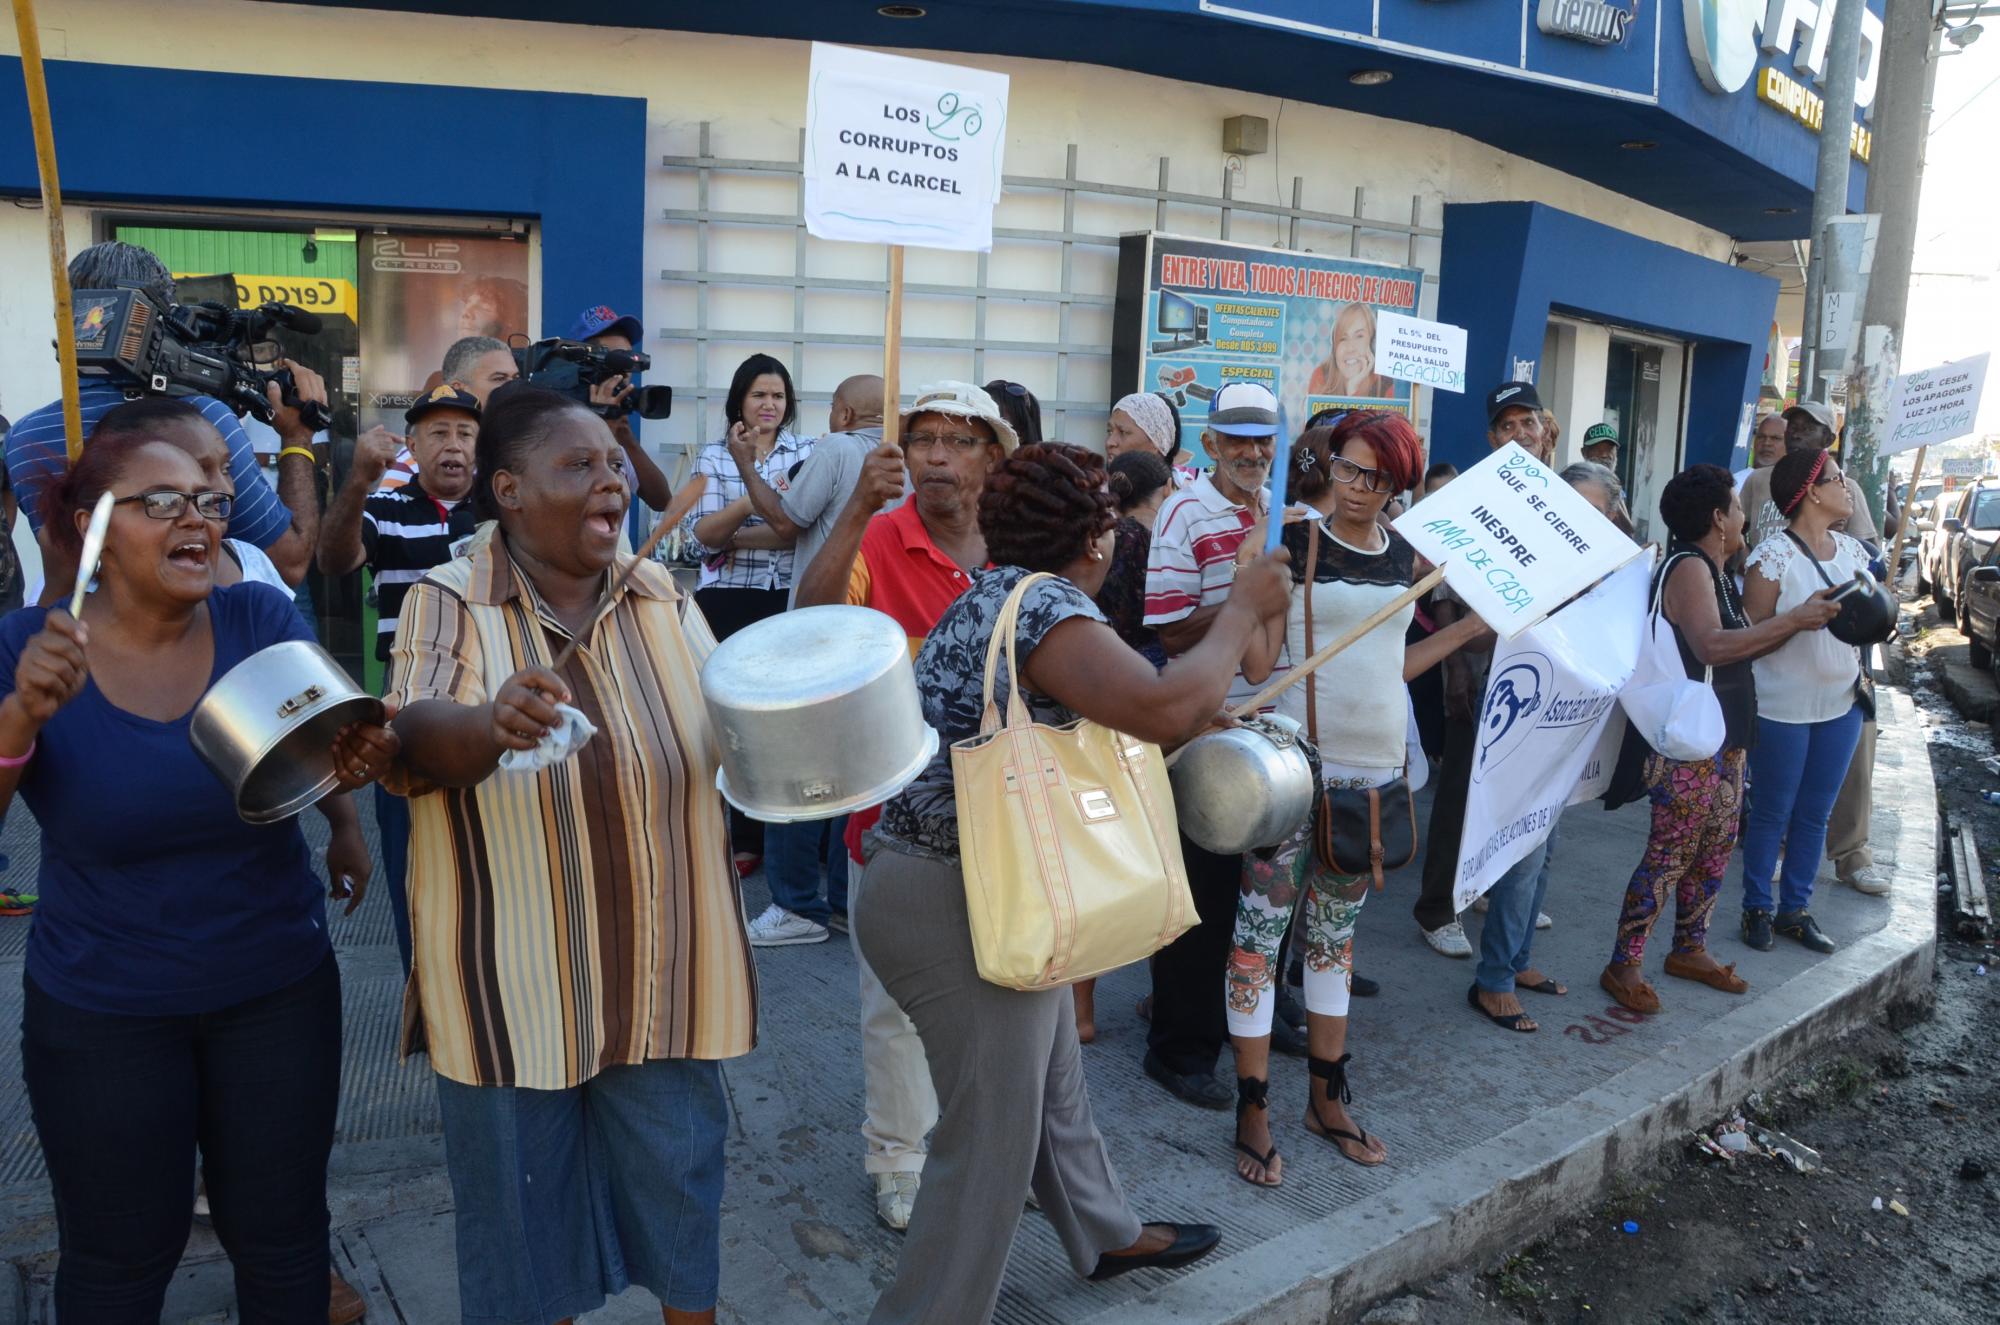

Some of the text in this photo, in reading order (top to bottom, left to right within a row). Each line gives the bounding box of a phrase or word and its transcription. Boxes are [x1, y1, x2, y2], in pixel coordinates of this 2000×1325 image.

[1552, 0, 1627, 44] Genius
[884, 104, 921, 123] LOS
[839, 130, 958, 162] CORRUPTOS
[836, 162, 961, 195] A LA CARCEL
[1162, 255, 1415, 307] ENTRE Y VEA, TODOS A PRECIOS DE LOCURA
[1215, 304, 1280, 317] OFERTAS CALIENTES
[1229, 327, 1264, 338] Completa
[1398, 327, 1441, 341] EL 5% DEL
[1216, 339, 1239, 350] Desde
[1391, 338, 1448, 355] PRESUPUESTO
[1388, 351, 1450, 368] PARA LA SALUD
[1221, 367, 1275, 379] ESPECIAL
[1914, 373, 1969, 392] QUE CESEN
[1902, 384, 1973, 407] LOS APAGONES
[1905, 399, 1965, 418] LUZ 24 HORA
[1500, 470, 1591, 554] QUE SE CIERRE
[1470, 505, 1537, 567] INESPRE
[1422, 519, 1534, 613] AMA DE CASA
[1538, 808, 1548, 829] DE
